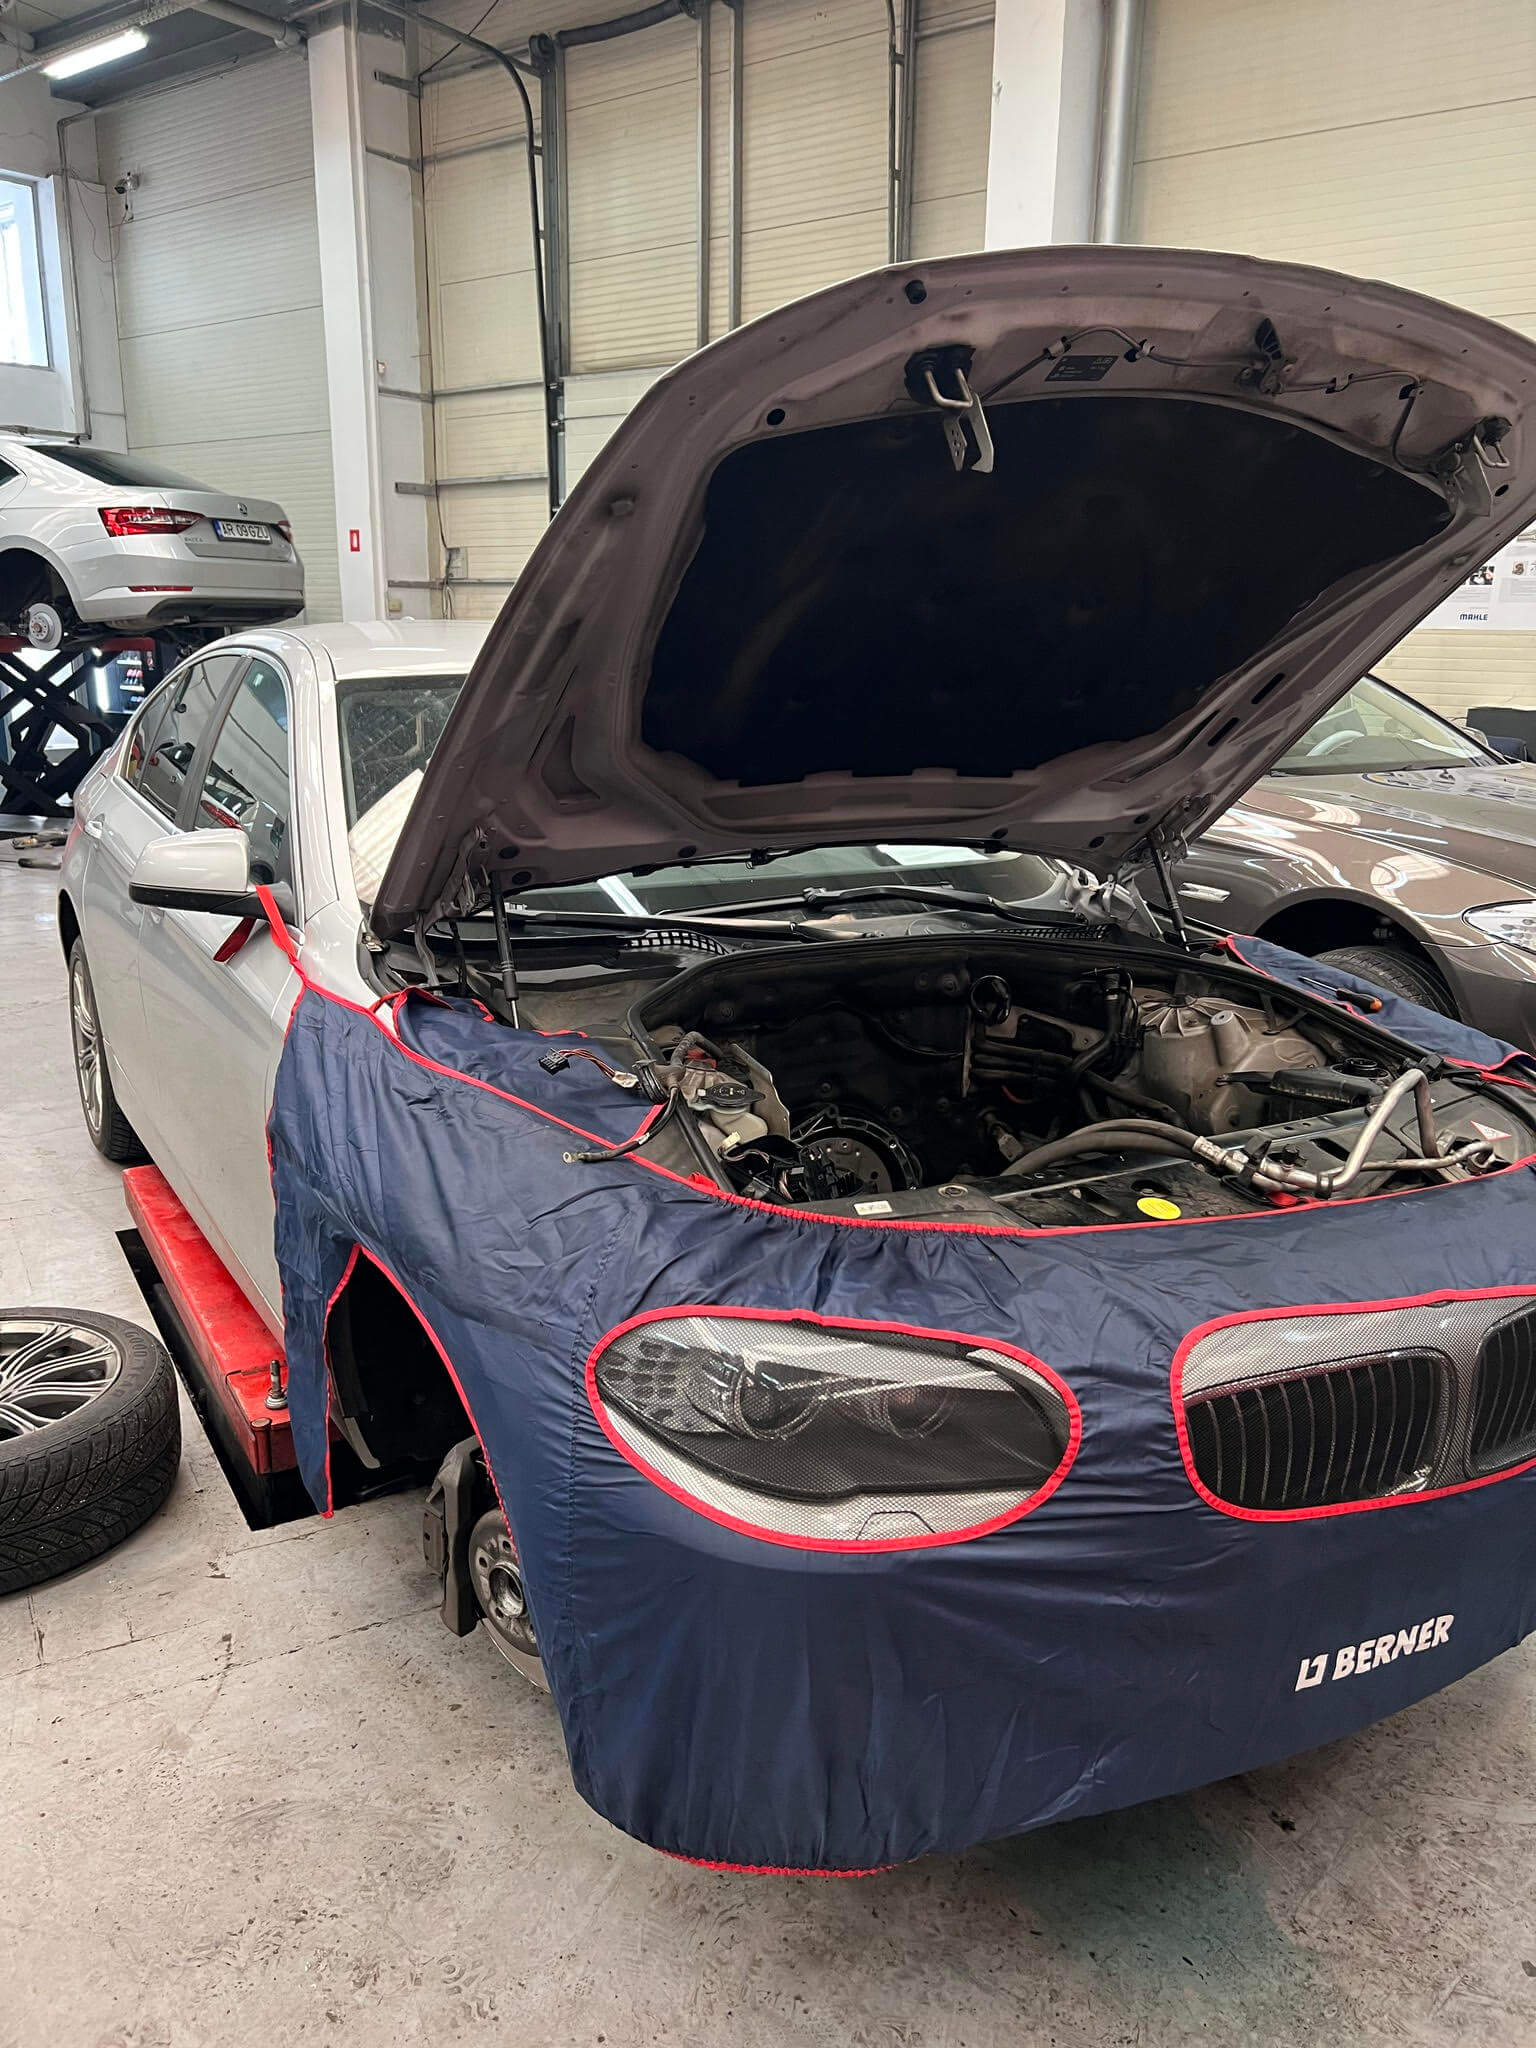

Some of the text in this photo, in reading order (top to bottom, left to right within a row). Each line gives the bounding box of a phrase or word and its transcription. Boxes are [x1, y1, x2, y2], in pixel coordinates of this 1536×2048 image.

[222, 522, 236, 536] AR
[1459, 613, 1489, 621] MAHLE
[1332, 1614, 1455, 1681] BERNER
